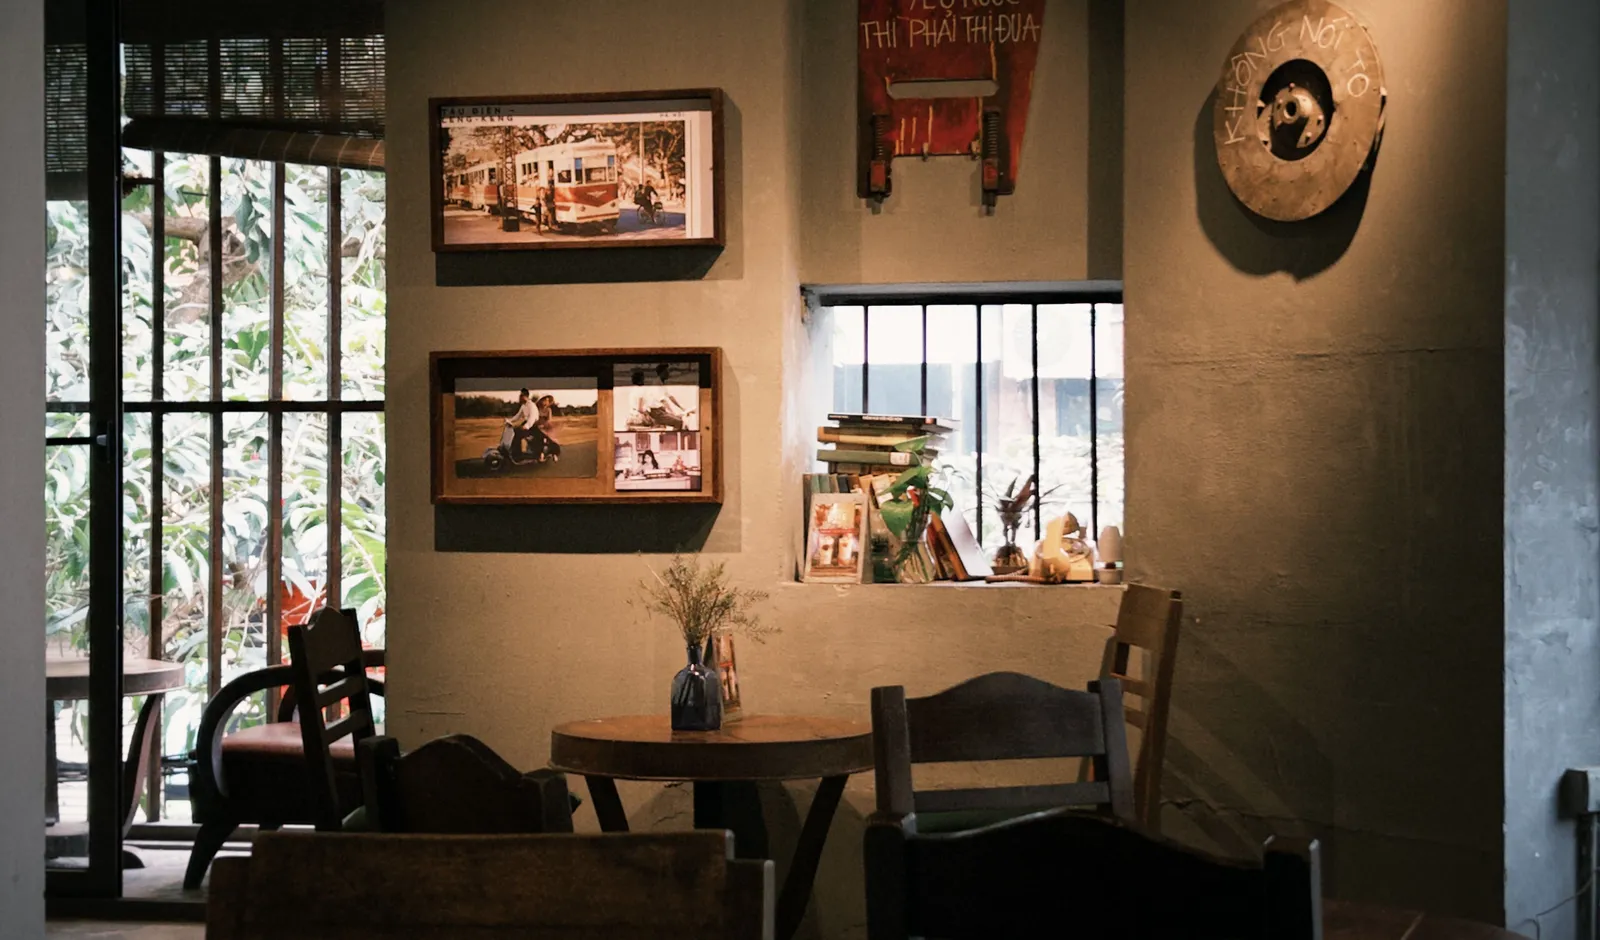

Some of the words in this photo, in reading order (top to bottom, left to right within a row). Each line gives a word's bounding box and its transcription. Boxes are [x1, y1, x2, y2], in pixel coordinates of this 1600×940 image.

[909, 9, 957, 48] PHẢI
[994, 13, 1040, 43] ĐUA
[1224, 21, 1290, 144] KHÔNG
[1346, 49, 1370, 98] TO
